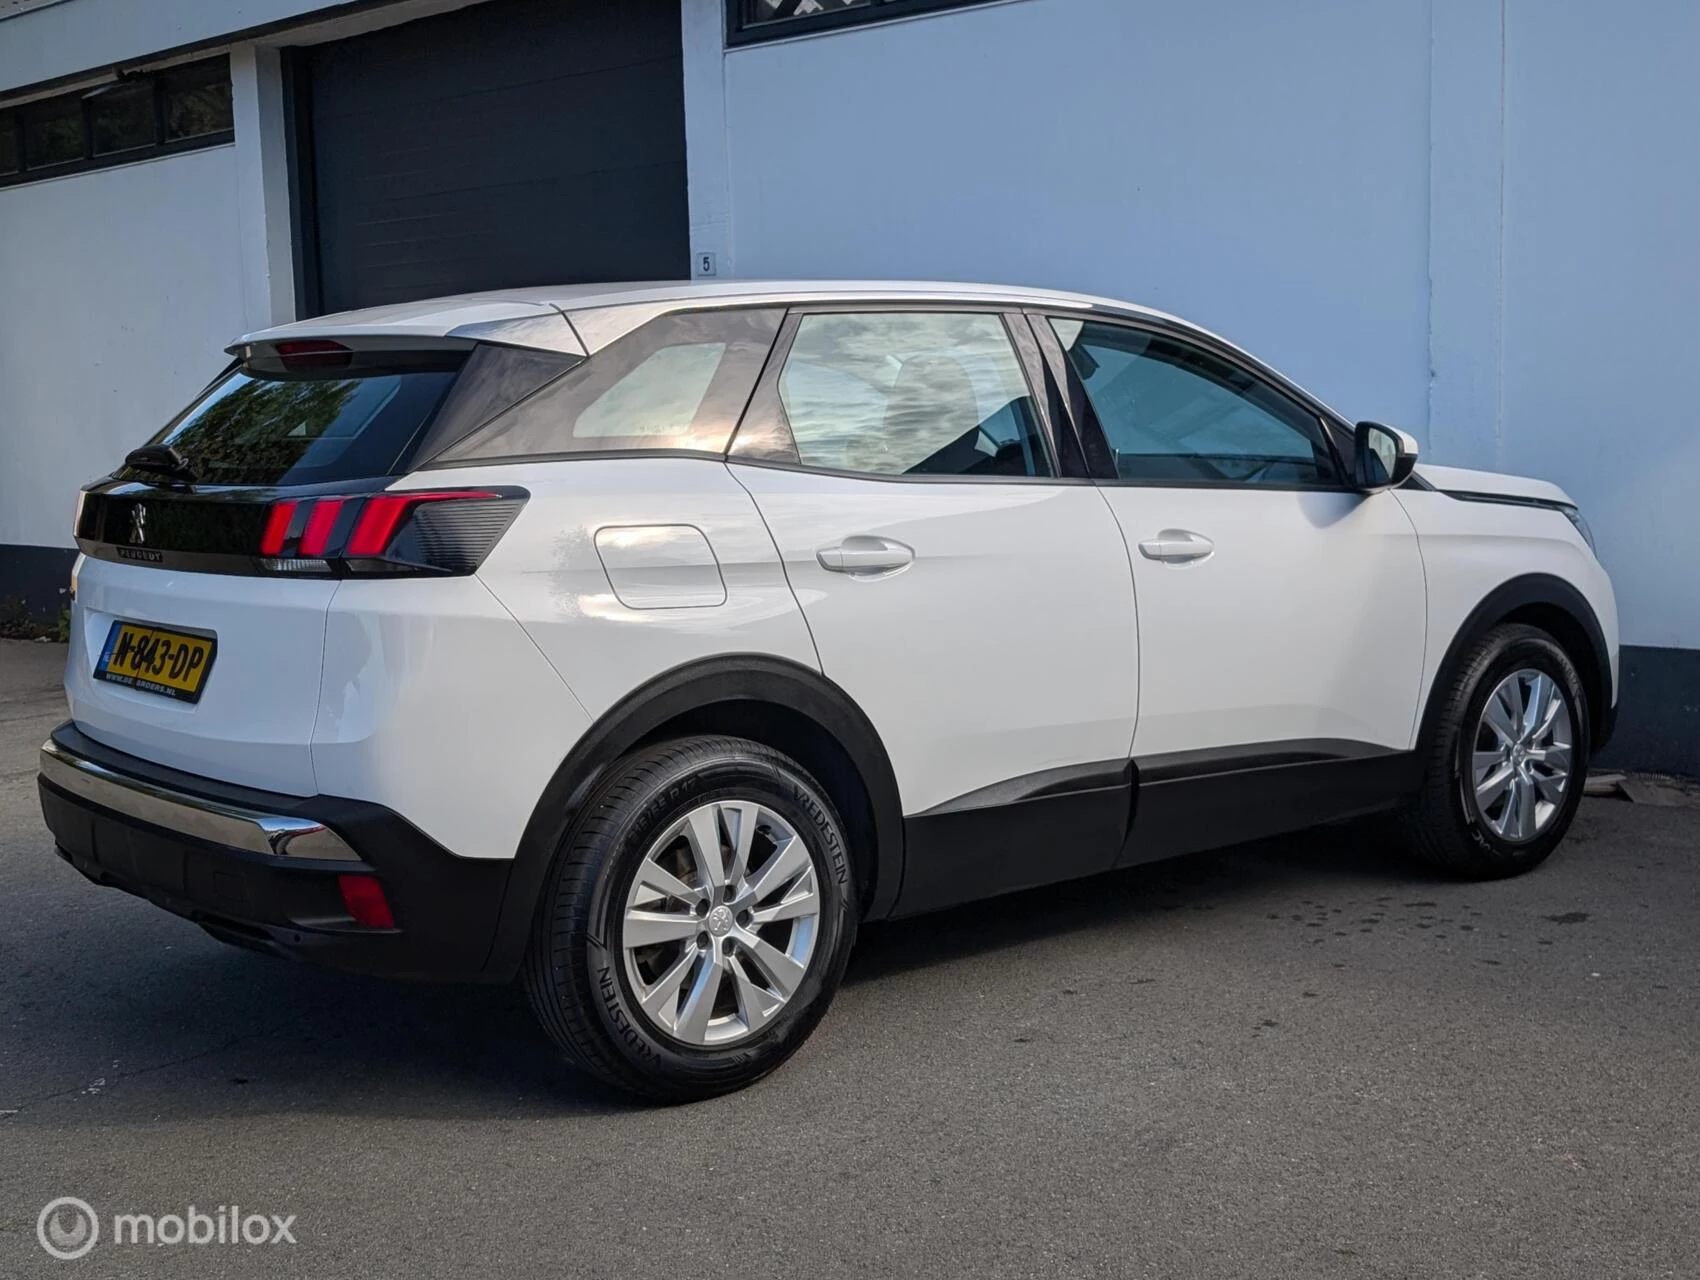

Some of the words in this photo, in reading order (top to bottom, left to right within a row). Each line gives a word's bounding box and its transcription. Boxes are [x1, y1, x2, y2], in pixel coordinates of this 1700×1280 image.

[702, 256, 711, 272] 5
[112, 631, 204, 683] N-843-DP
[793, 785, 848, 885] VREDESTEIN
